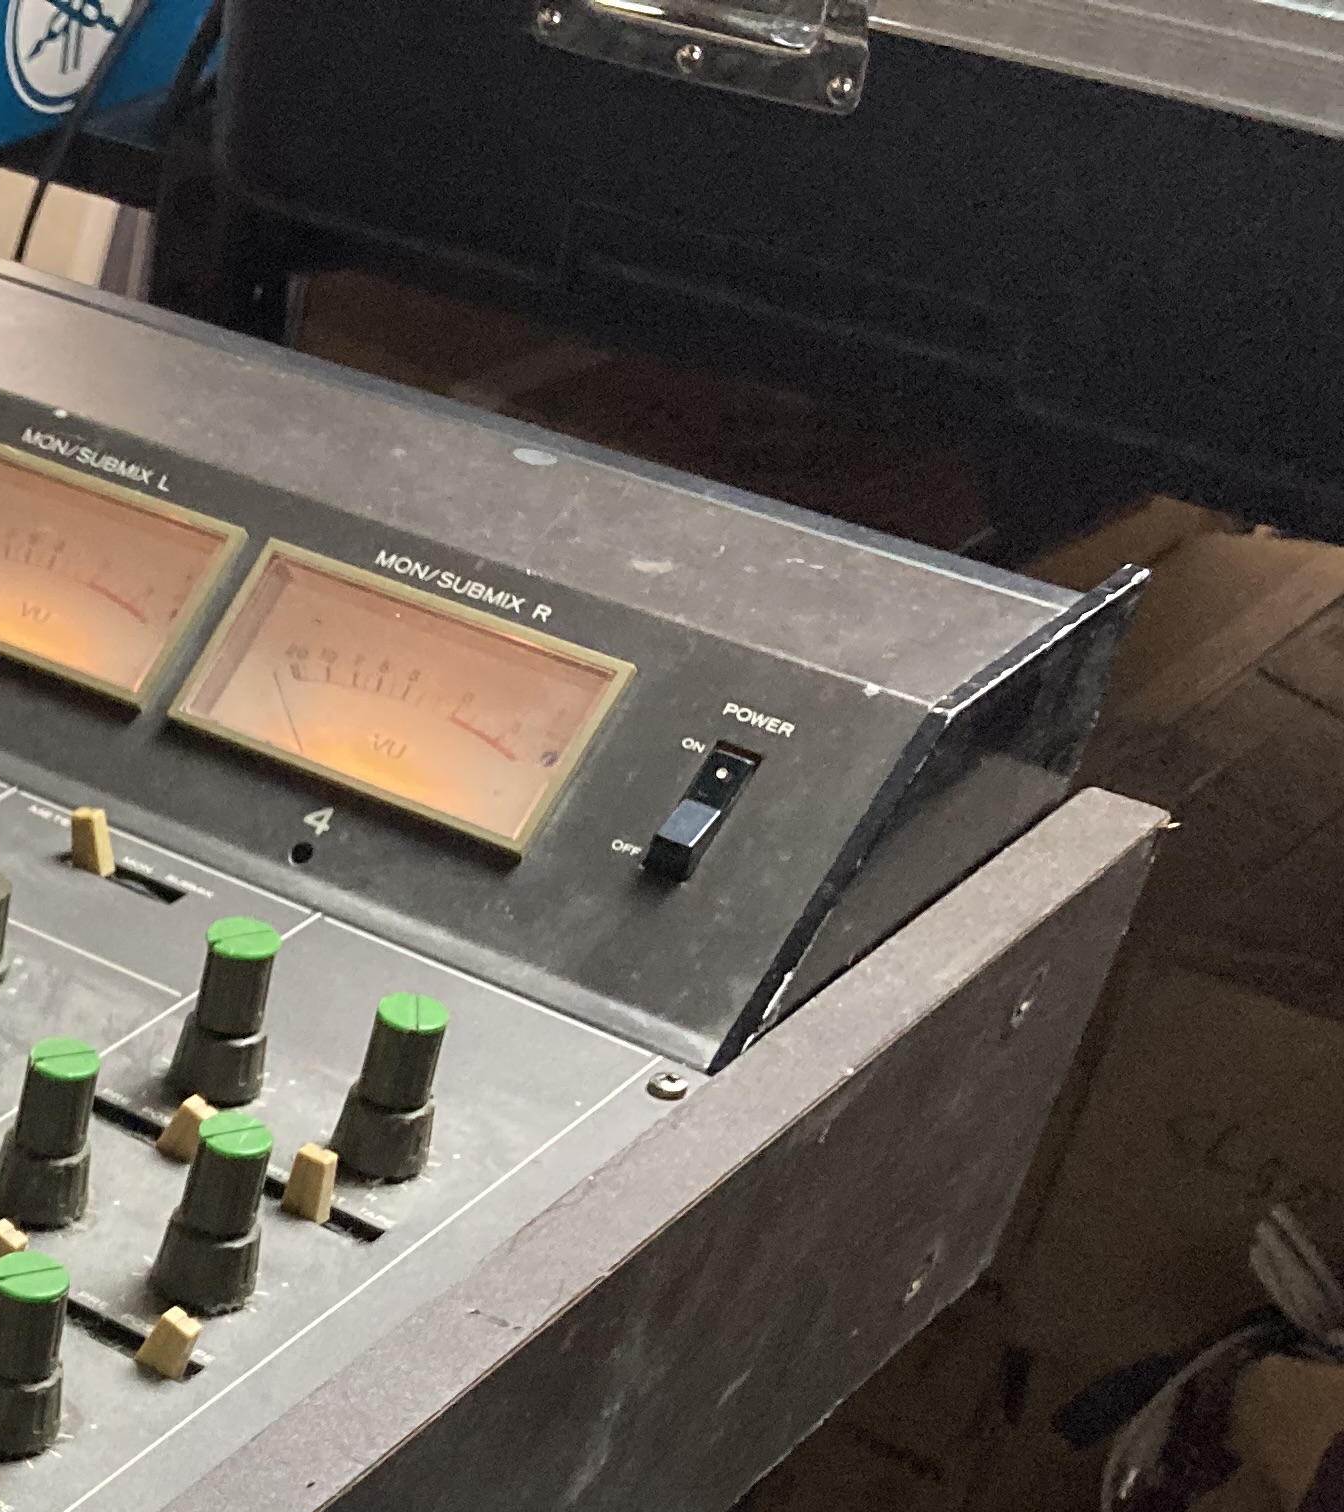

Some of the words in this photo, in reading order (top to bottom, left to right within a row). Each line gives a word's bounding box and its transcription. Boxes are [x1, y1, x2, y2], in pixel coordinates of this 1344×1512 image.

[21, 426, 153, 485] MON/SUBMIX
[157, 473, 170, 492] L
[374, 549, 525, 613] MON/SUBMIX
[532, 603, 553, 623] R
[722, 702, 795, 738] POWER
[681, 737, 706, 754] ON
[303, 806, 334, 835] 4
[612, 839, 643, 857] OFF
